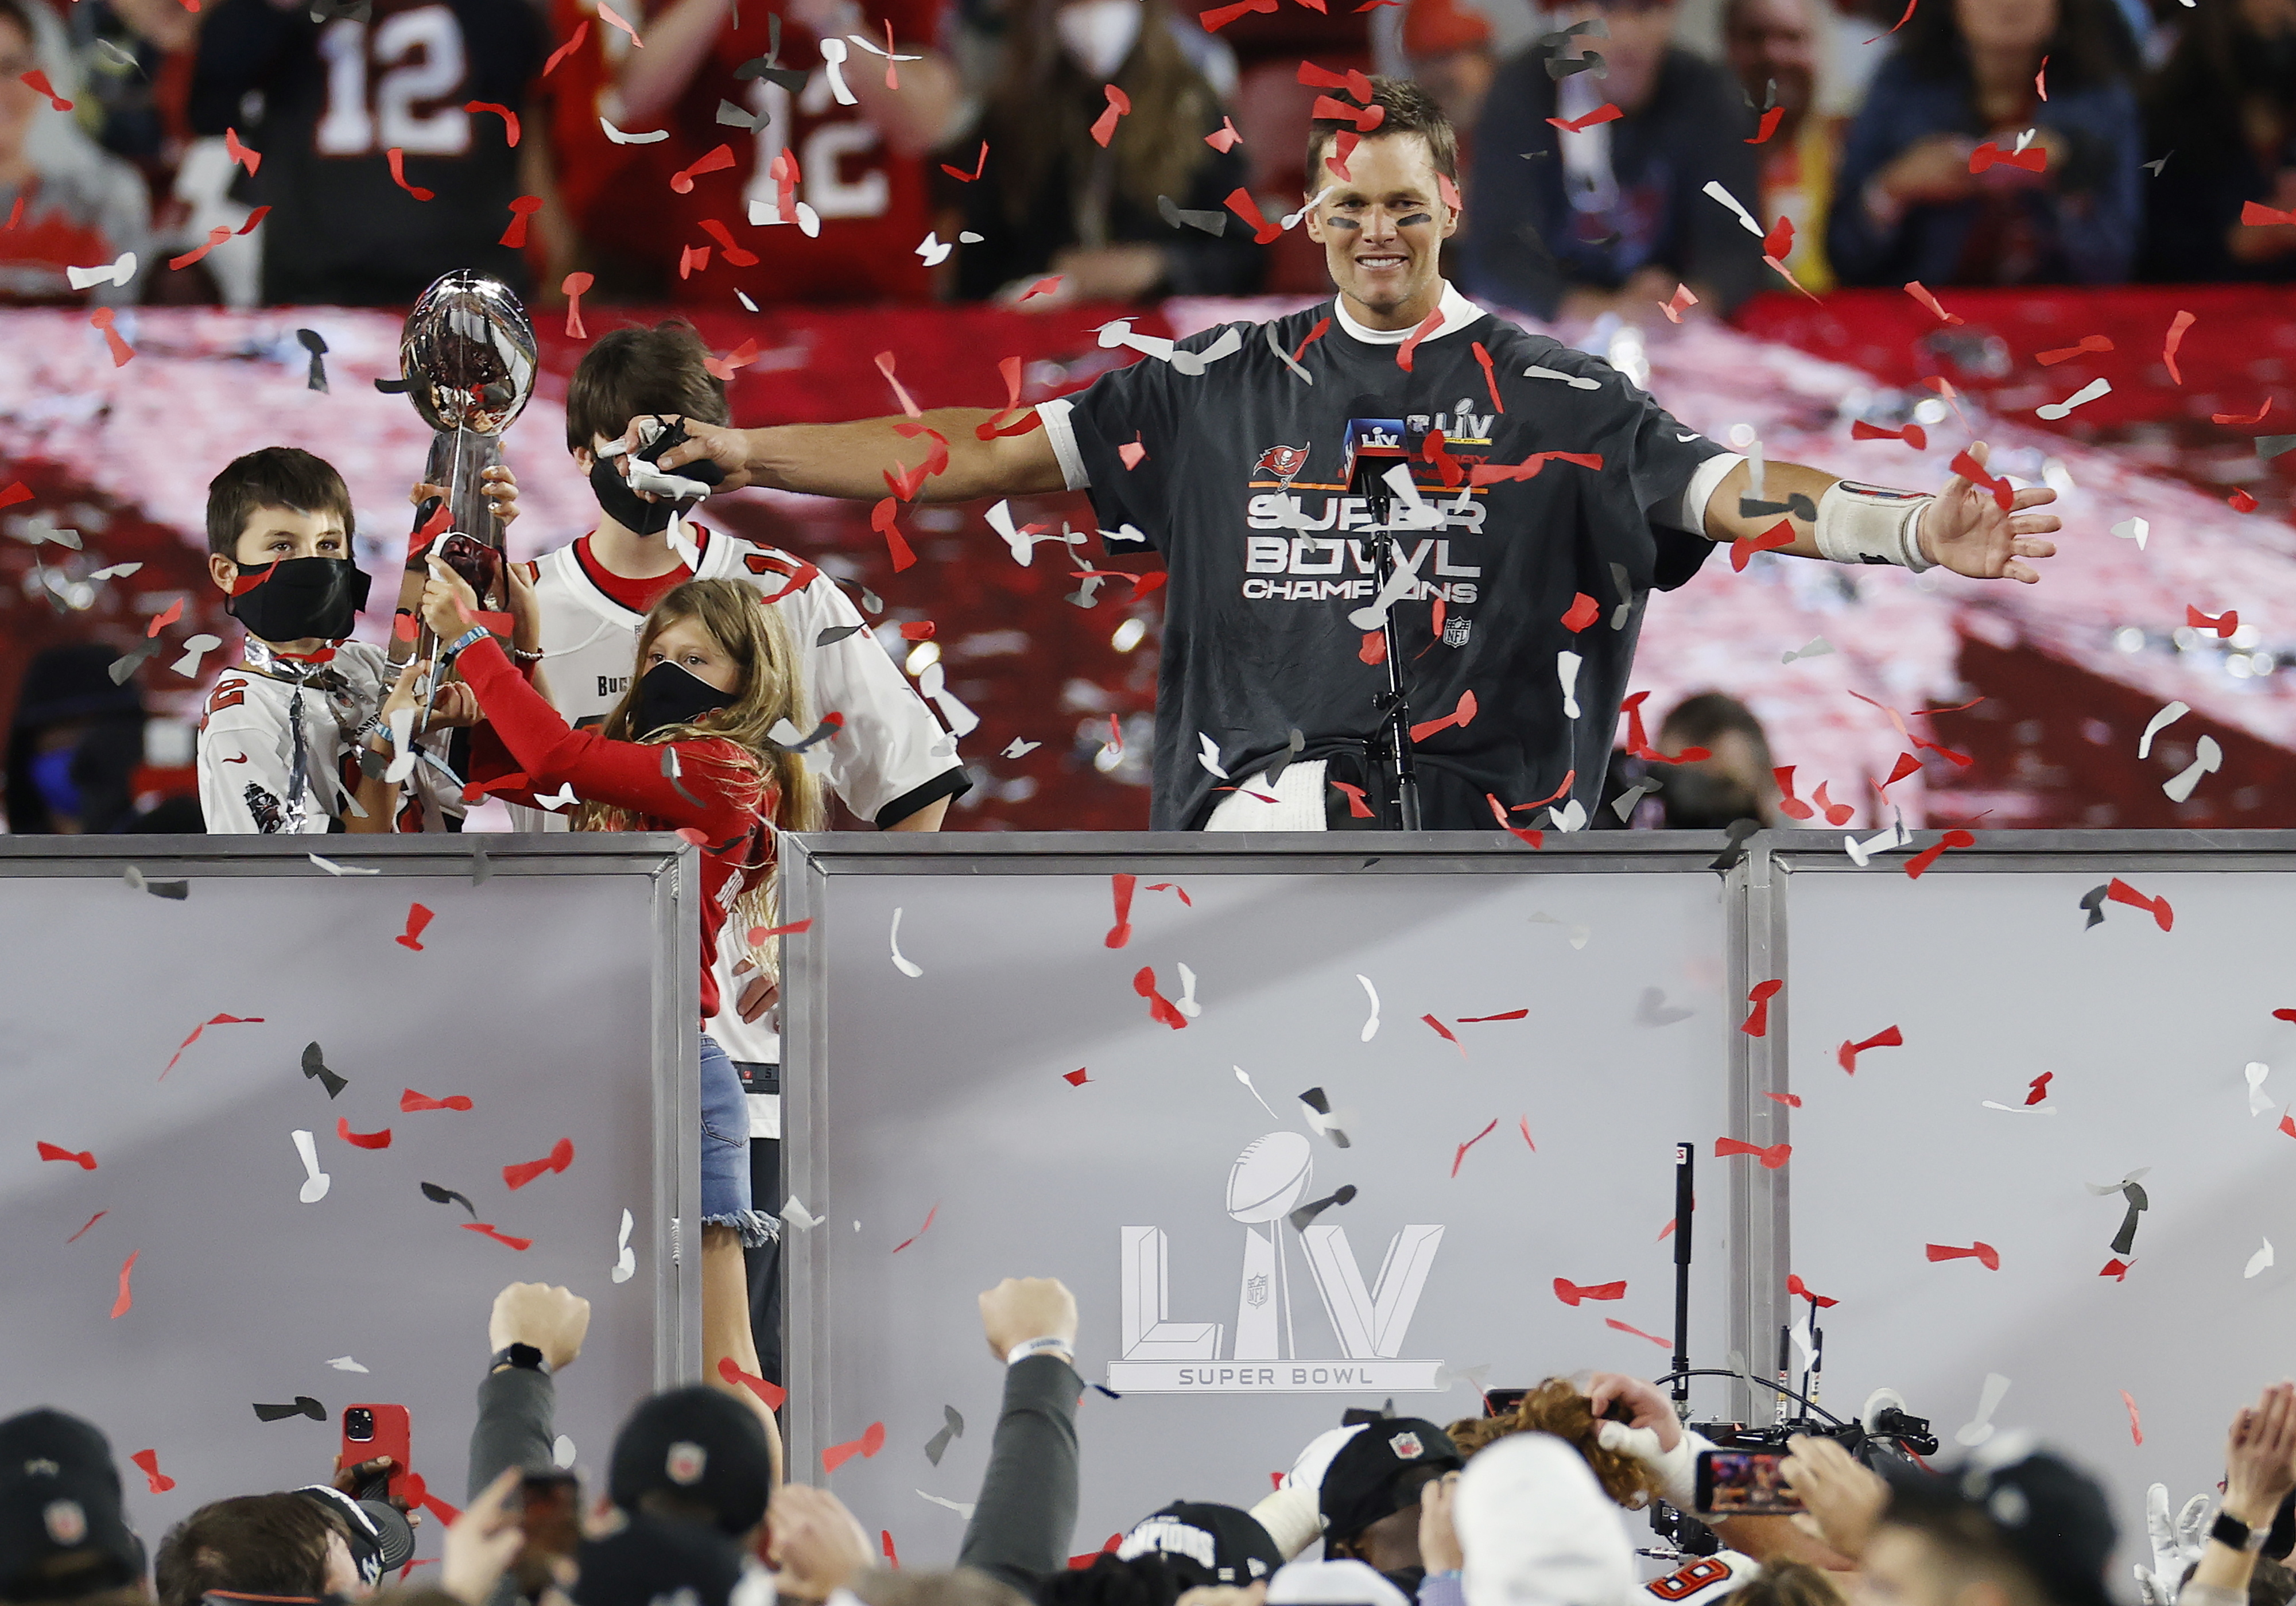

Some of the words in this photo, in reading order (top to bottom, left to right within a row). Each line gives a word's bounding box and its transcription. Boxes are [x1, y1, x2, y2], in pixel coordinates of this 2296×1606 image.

[316, 4, 471, 154] 12
[742, 60, 891, 218] 12
[1361, 427, 1399, 446] LIV
[1435, 398, 1495, 439] LIV
[1246, 537, 1481, 577] BOWL
[1243, 579, 1478, 603] CHAMPONS
[1447, 629, 1468, 643] NFL
[1120, 1131, 1445, 1360] LIV
[1178, 1368, 1274, 1384] SUPER
[1292, 1368, 1372, 1384] BOWL
